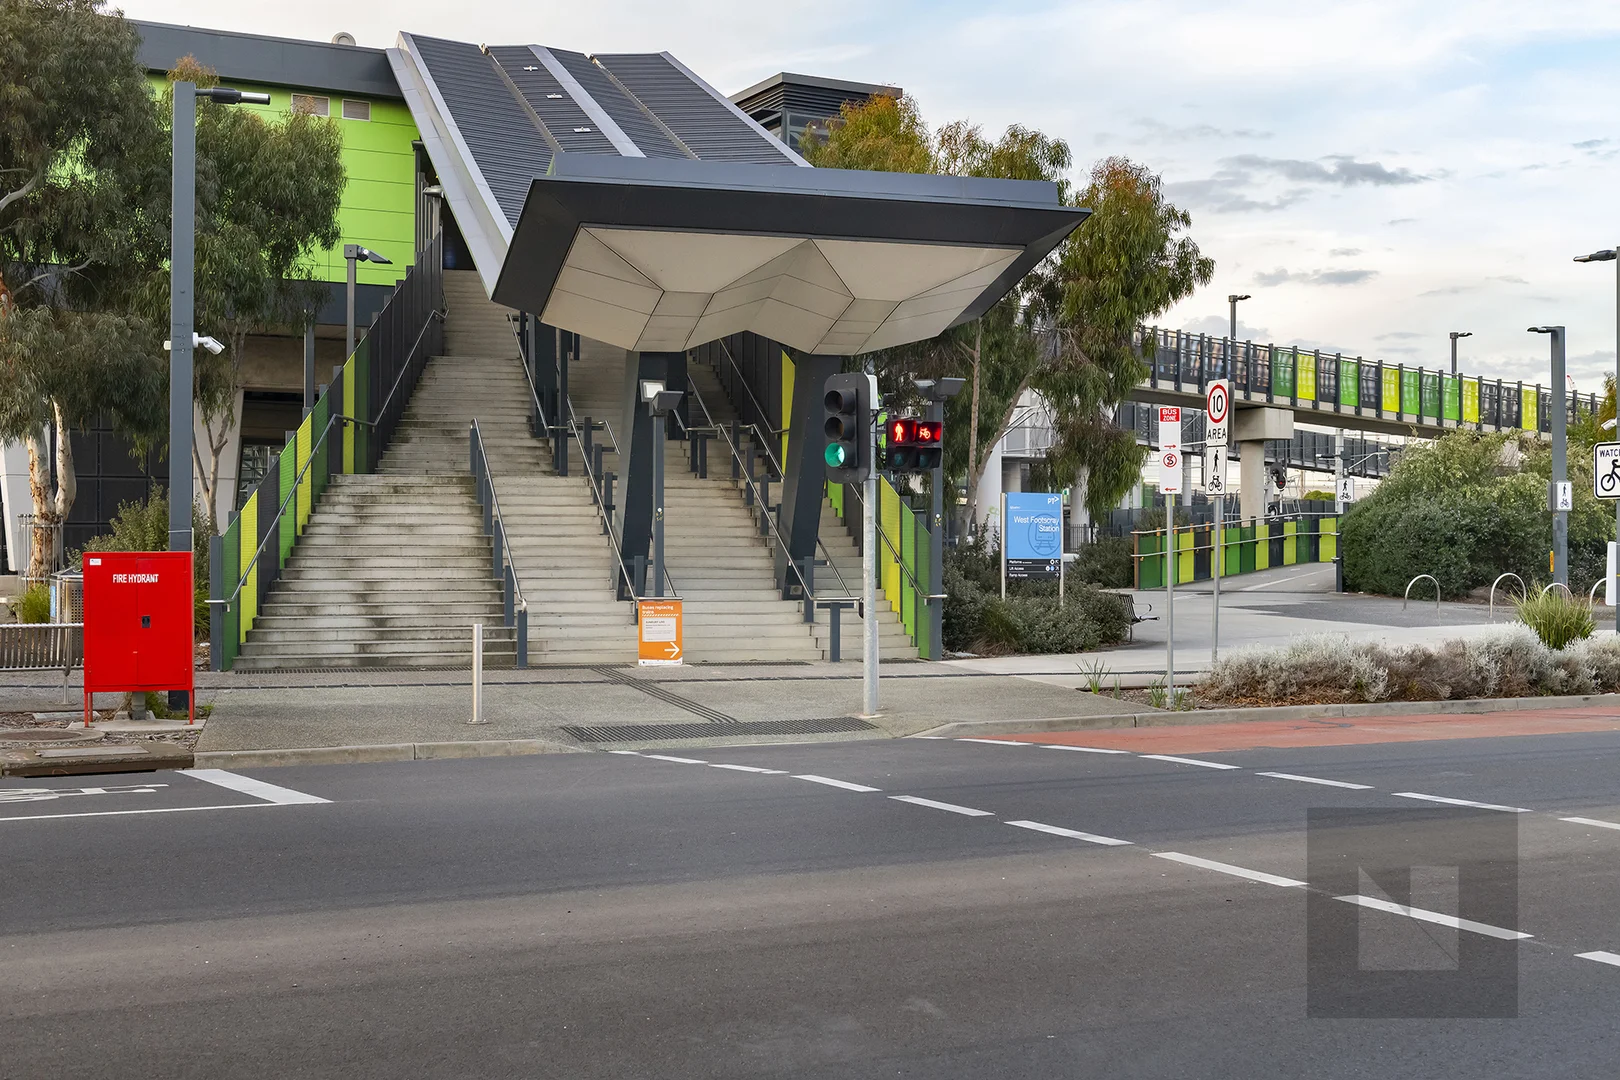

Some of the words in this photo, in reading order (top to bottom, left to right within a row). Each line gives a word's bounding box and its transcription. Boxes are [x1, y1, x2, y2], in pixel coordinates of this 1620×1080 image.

[1212, 394, 1223, 413] 10
[1207, 428, 1226, 439] AREA
[1013, 516, 1029, 524] West
[1030, 516, 1060, 525] Footscray
[1038, 524, 1060, 532] Station
[113, 574, 127, 583] FIRE
[128, 574, 159, 583] HYDRANT
